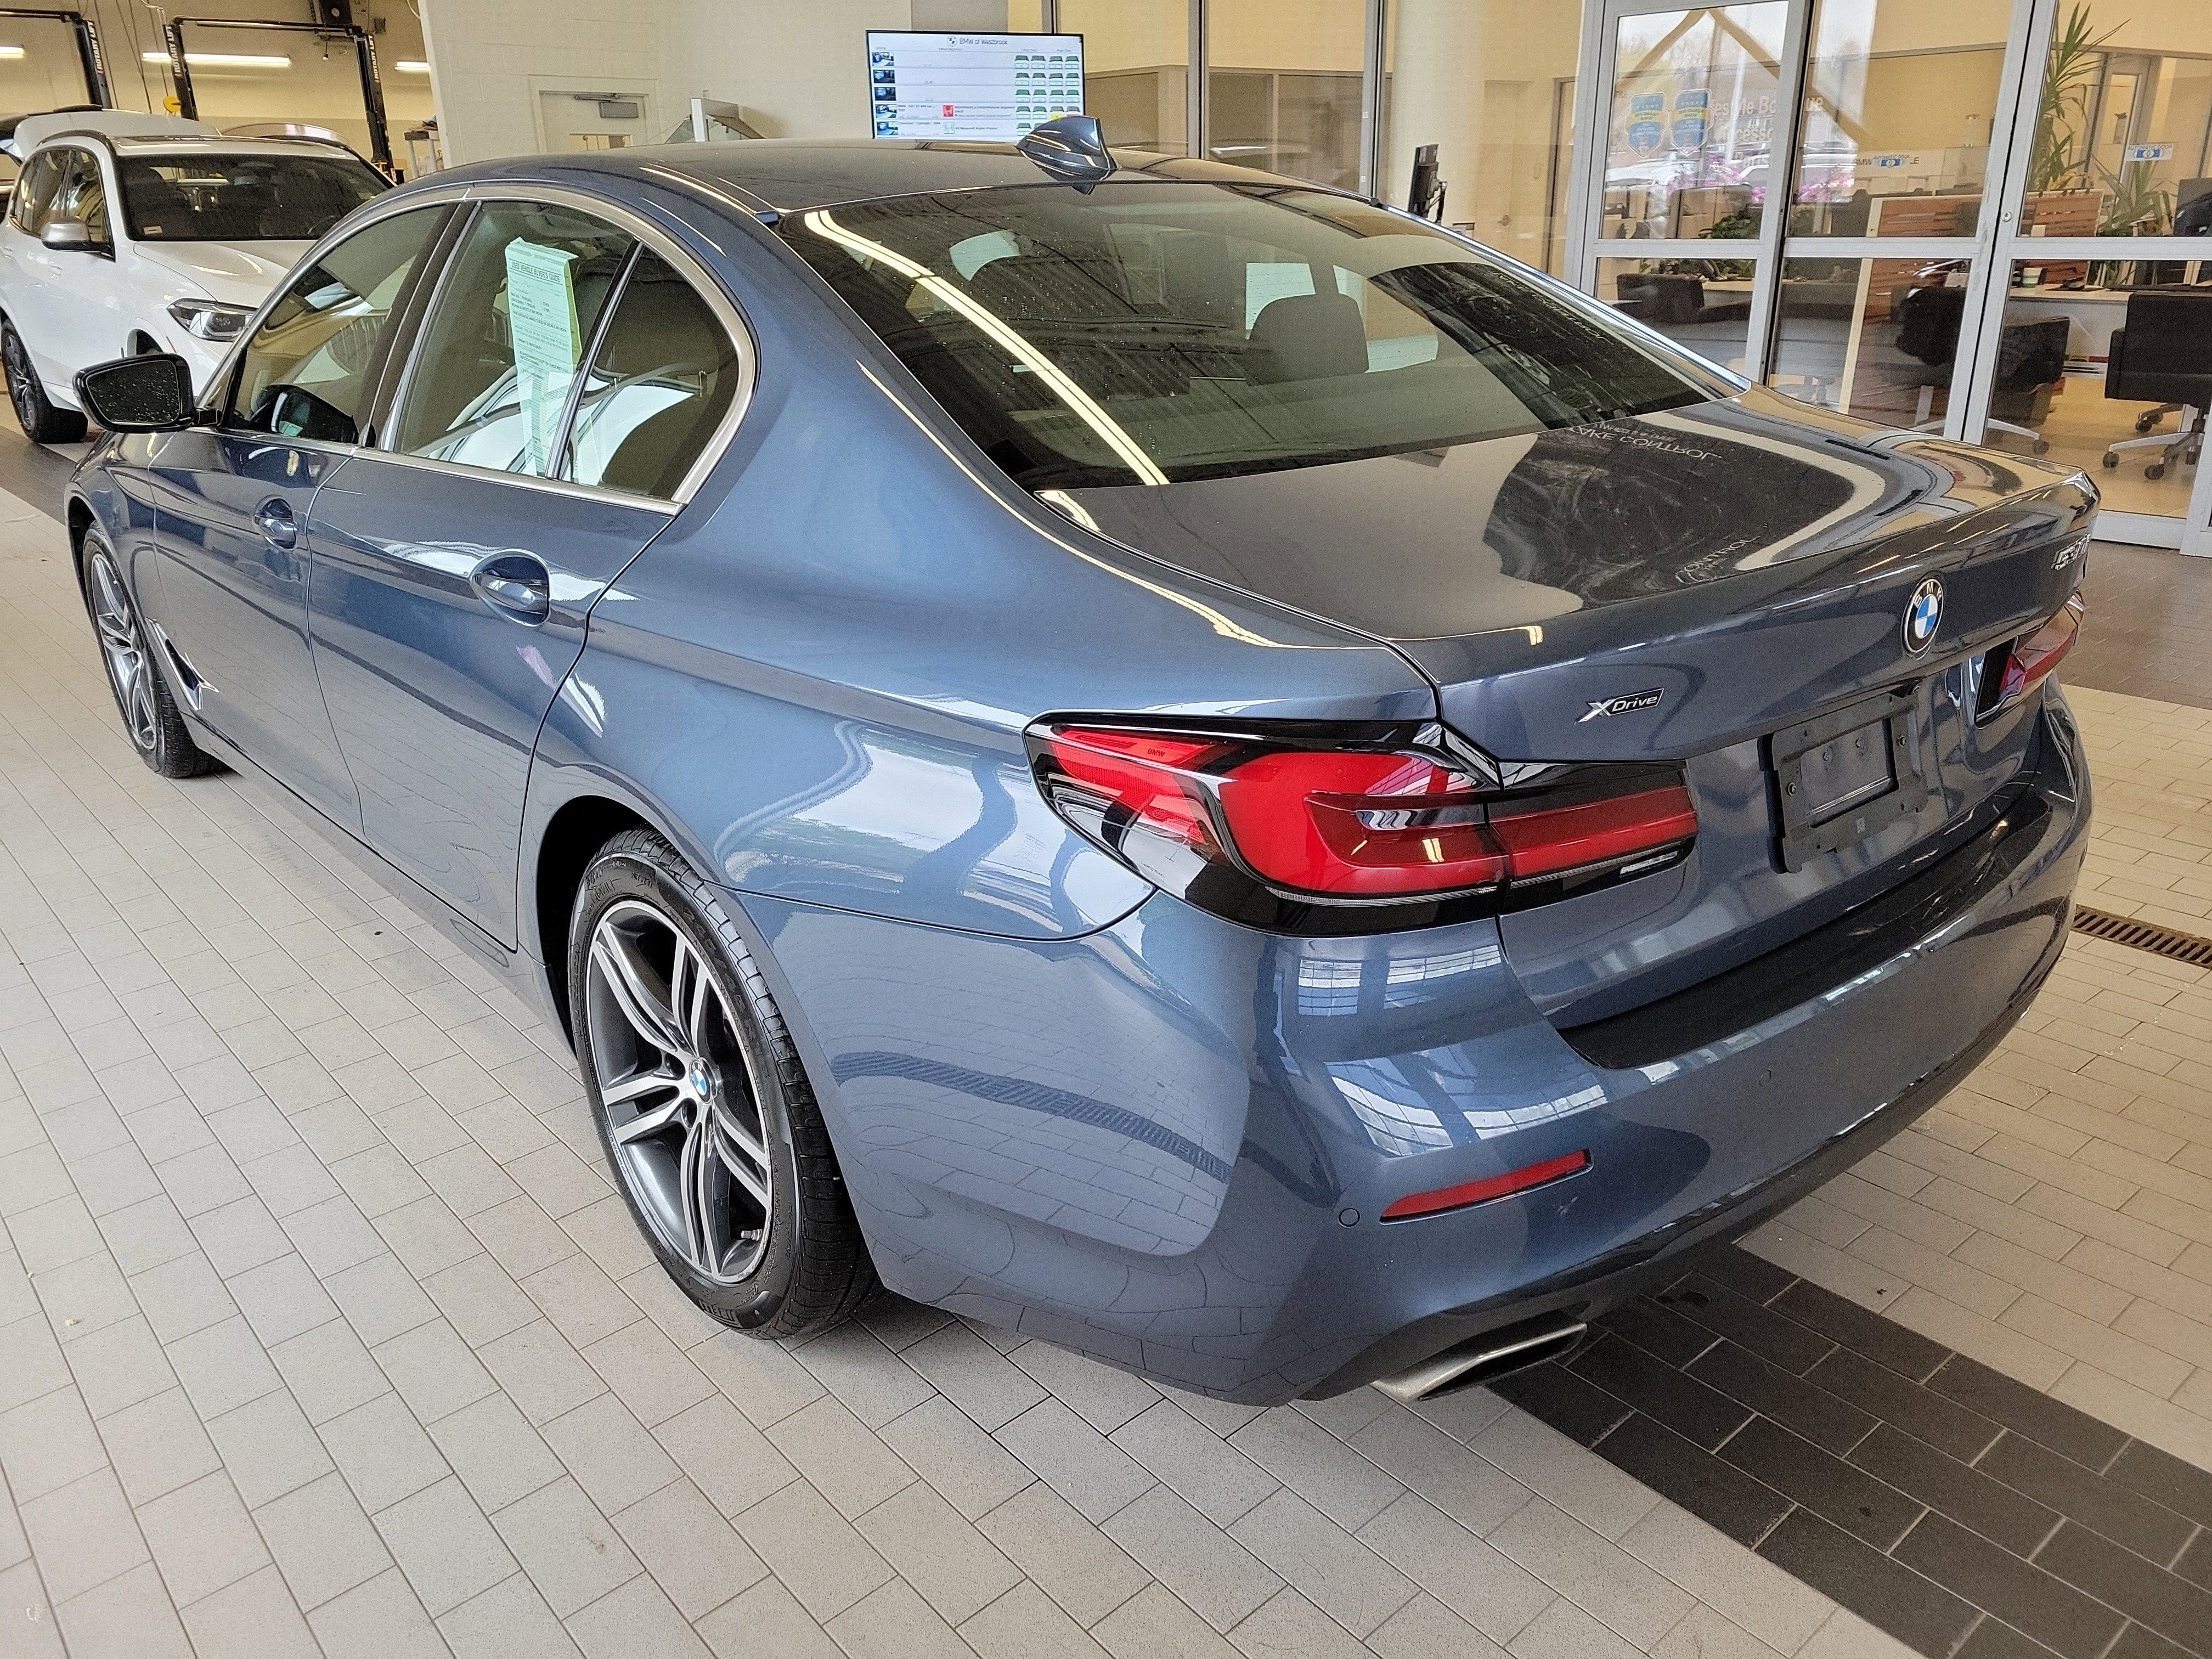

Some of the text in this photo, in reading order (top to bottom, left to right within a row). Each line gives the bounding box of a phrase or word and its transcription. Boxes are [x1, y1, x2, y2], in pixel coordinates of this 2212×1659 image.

[87, 21, 104, 70] ROTARY LIFT
[165, 25, 182, 73] ROTARY LIFT
[370, 50, 380, 80] ROTARY
[511, 261, 561, 283] USED VEHICLE BUYER'S GUIDE
[1914, 582, 1943, 609] BMW
[1147, 748, 1166, 758] BMW
